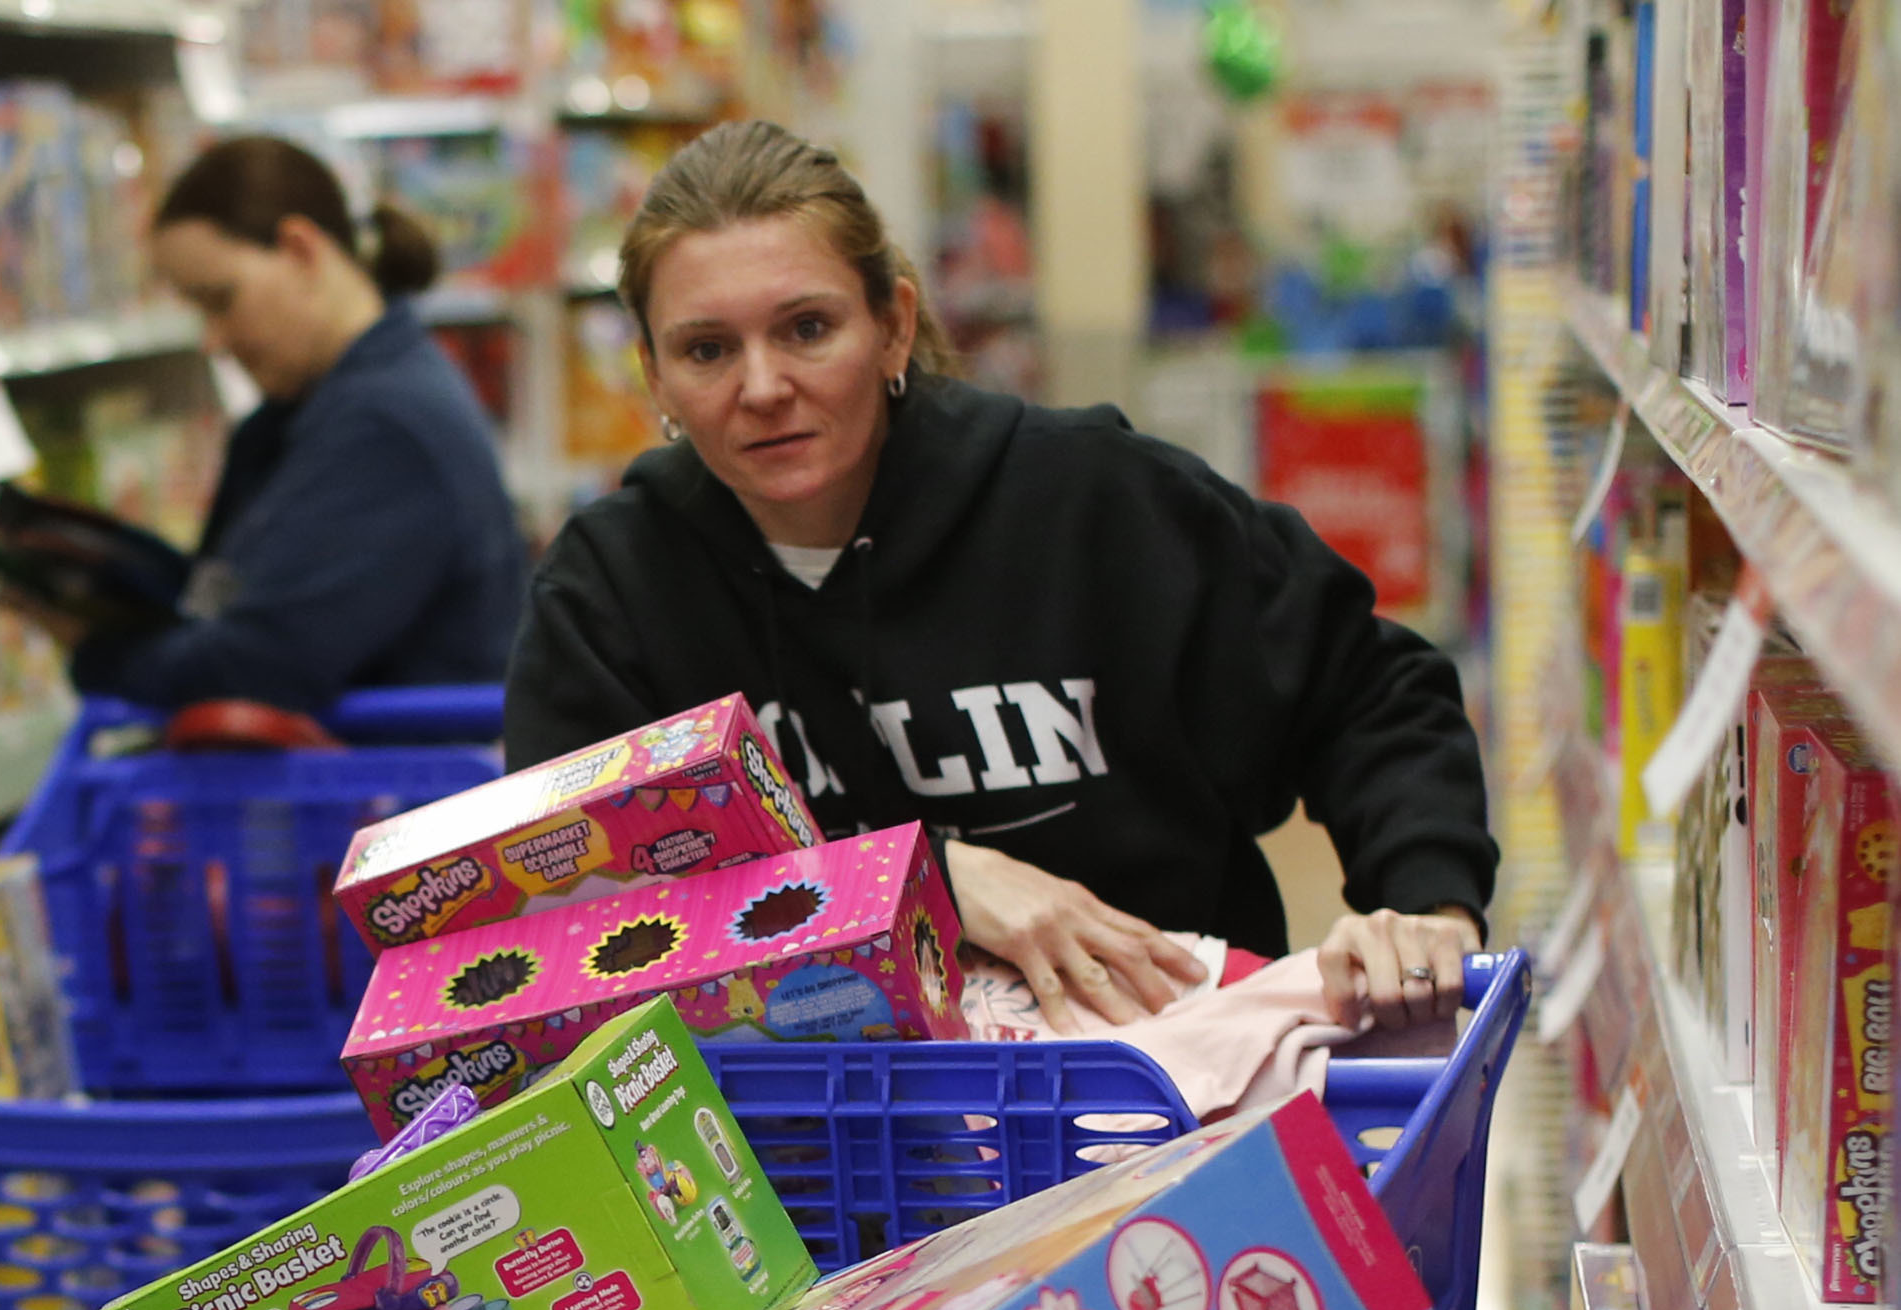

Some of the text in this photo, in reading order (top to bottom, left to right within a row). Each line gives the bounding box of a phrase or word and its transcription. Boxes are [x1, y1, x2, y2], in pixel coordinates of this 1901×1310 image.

[756, 678, 1108, 796] LIN
[744, 738, 817, 849] Shopkins
[502, 819, 592, 863] SUPERMARKET
[522, 838, 590, 874] SCRAMBLE
[632, 843, 656, 875] 4
[371, 857, 482, 934] Shopkins
[541, 860, 580, 882] GAME
[395, 1043, 512, 1118] Shopkins
[613, 1073, 650, 1115] Picnic
[639, 1044, 679, 1091] Basket
[389, 1117, 572, 1219] colors/colours as you play picnic.
[398, 1112, 548, 1198] Explore shapes, manners &
[436, 1211, 463, 1230] cookie
[462, 1206, 472, 1217] is
[438, 1208, 492, 1241] Can you find
[438, 1232, 470, 1253] another
[178, 1222, 319, 1302] Shapes & Sharing
[252, 1233, 347, 1298] Basket
[502, 1235, 565, 1273] Butterfly Button
[597, 1282, 619, 1298] Mode
